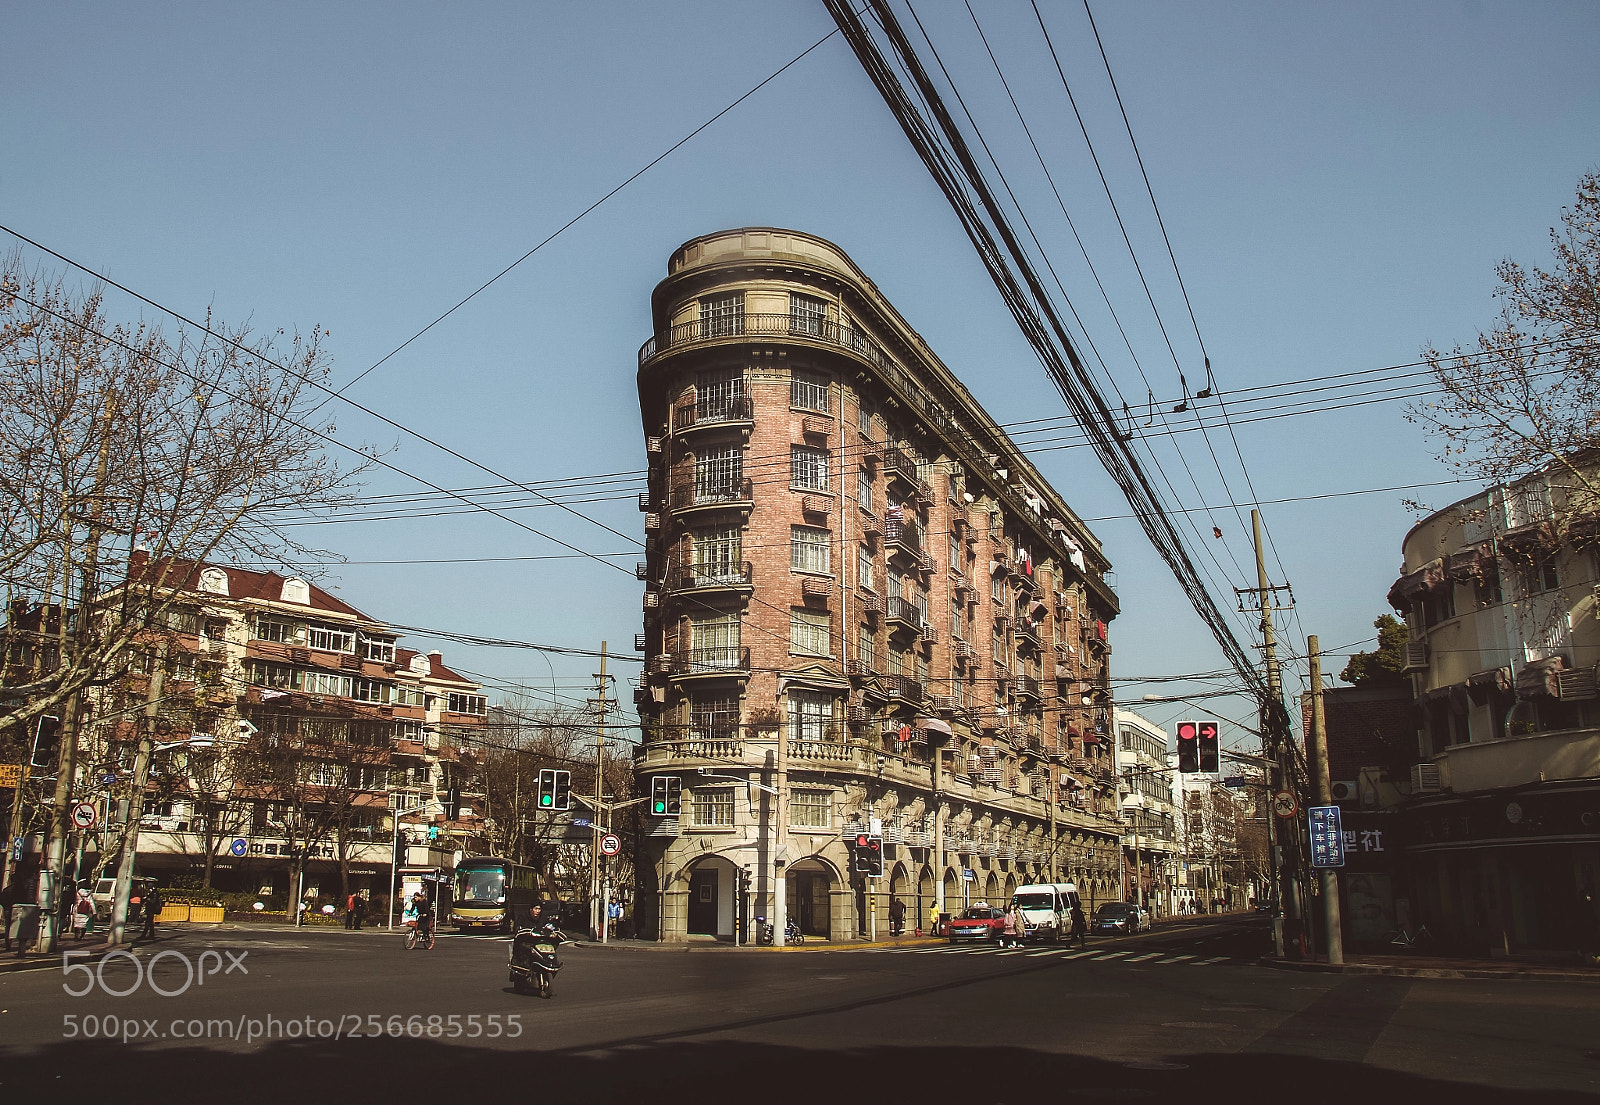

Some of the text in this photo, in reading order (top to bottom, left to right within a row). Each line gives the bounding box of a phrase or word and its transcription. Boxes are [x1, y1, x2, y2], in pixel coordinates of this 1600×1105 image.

[1314, 811, 1327, 864] 请下车推行
[1326, 808, 1339, 864] 人行道非机动车
